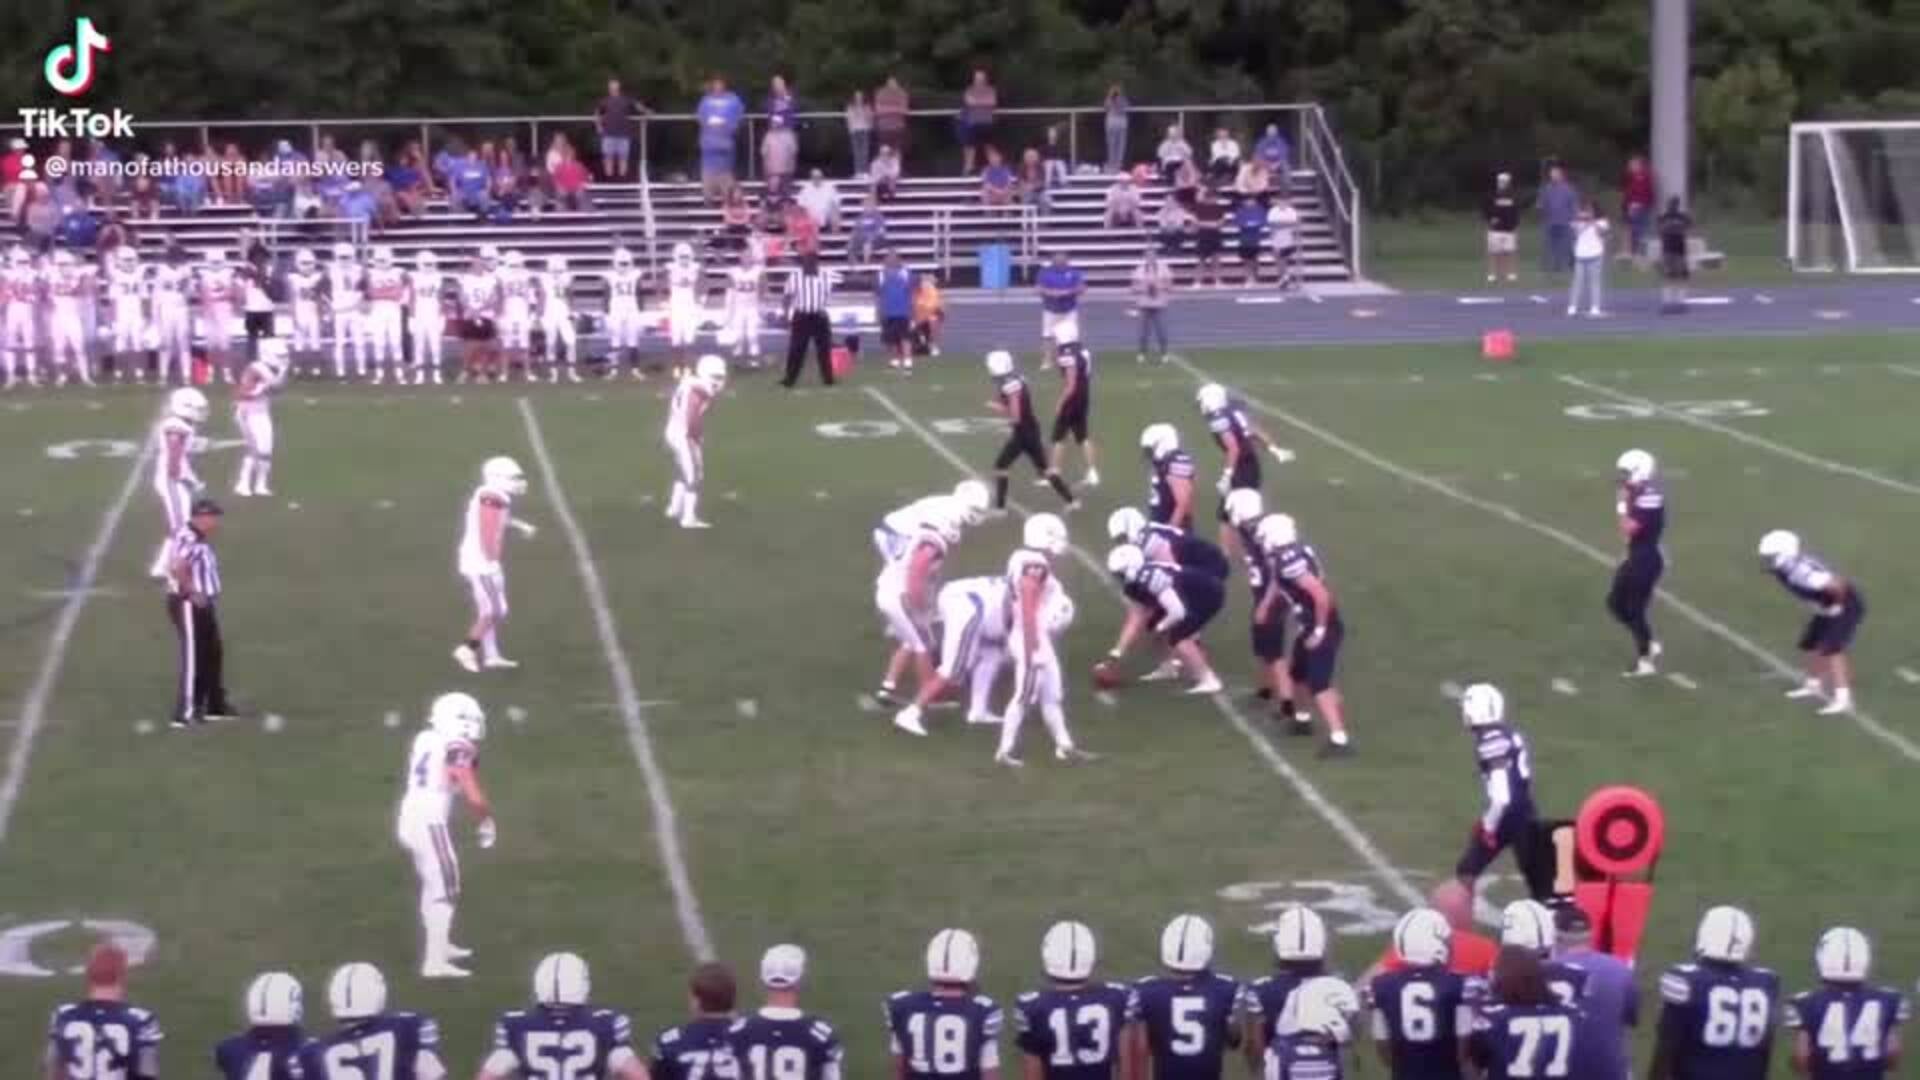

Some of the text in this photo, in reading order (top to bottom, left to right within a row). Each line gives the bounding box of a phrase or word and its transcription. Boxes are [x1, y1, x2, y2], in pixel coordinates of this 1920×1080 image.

[1048, 1004, 1110, 1066] 13
[1170, 997, 1205, 1055] 5
[1401, 982, 1436, 1041] 6
[1704, 985, 1770, 1048] 68
[1817, 1001, 1882, 1062] 44
[323, 1031, 396, 1080] 67
[527, 1030, 596, 1080] 52
[908, 1013, 967, 1073] 18
[1507, 1016, 1570, 1077] 77
